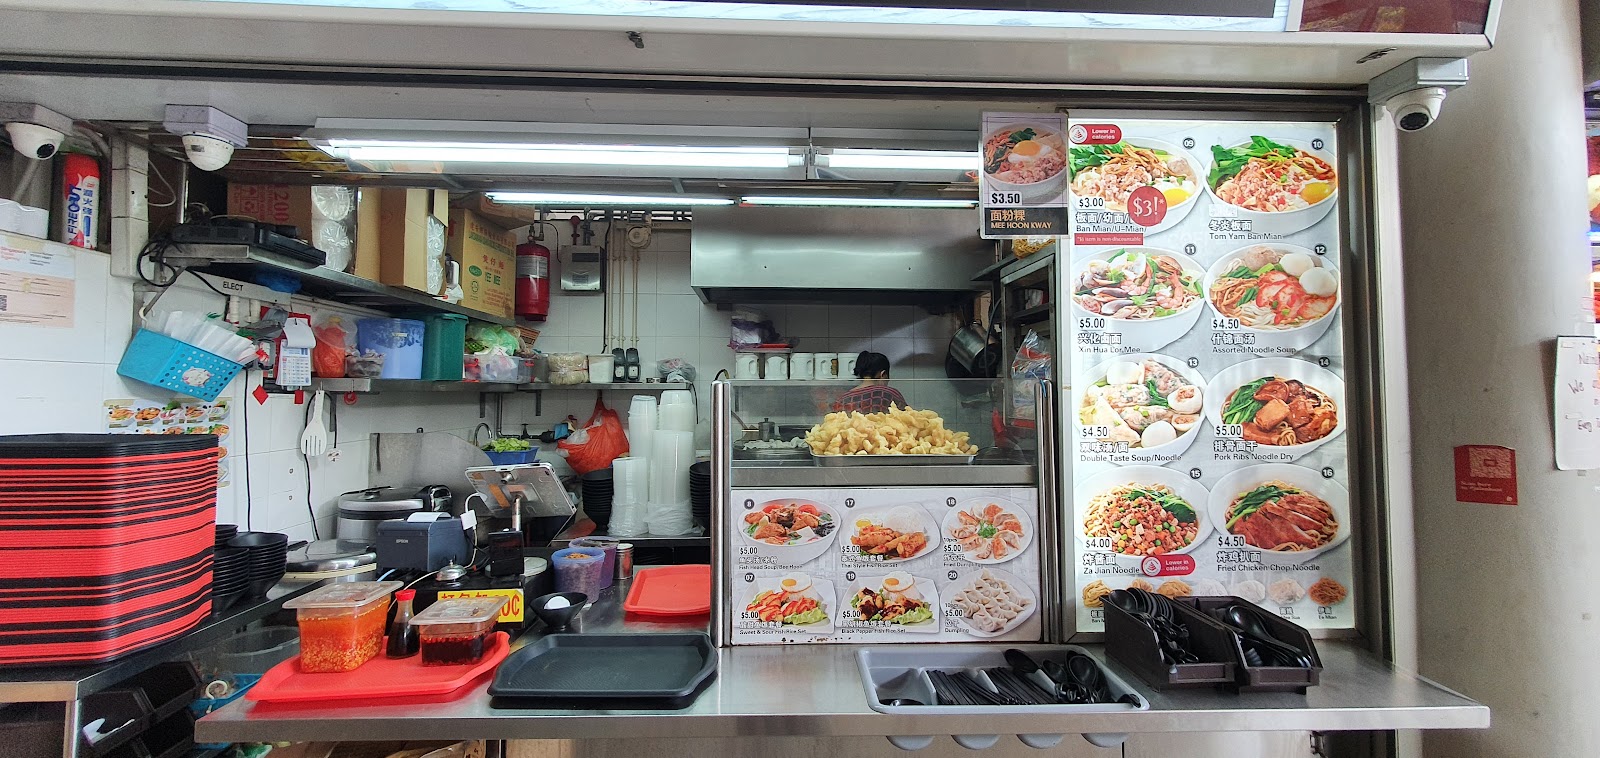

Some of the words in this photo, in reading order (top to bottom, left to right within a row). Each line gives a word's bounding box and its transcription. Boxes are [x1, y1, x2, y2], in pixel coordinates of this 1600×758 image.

[1313, 141, 1322, 149] 10
[991, 192, 1020, 204] $3.50
[1079, 197, 1104, 208] $3.00
[67, 183, 82, 235] FIREOUT
[990, 210, 1025, 221] 面粉粿
[1076, 225, 1091, 233] Ban
[1316, 246, 1325, 254] 12
[222, 281, 244, 292] ELECT
[1079, 318, 1105, 329] $5.00
[1212, 319, 1239, 329] $4.50
[1211, 333, 1255, 345] 什锦面汤
[1212, 346, 1246, 354] Assorted
[1248, 346, 1275, 354] Noodle
[1276, 346, 1297, 355] Soup
[1319, 358, 1329, 366] 14
[1082, 426, 1108, 437] $4.50
[1216, 425, 1242, 437] $5.00
[1191, 470, 1201, 478] 15
[1322, 469, 1333, 477] 16
[1085, 538, 1110, 549] $4.00
[1218, 536, 1245, 547] $4.50
[740, 547, 758, 555] $5.00
[841, 545, 860, 554] $5.00
[943, 544, 962, 552] $5.00
[1216, 551, 1262, 563] 炸鸡扒面
[1217, 564, 1236, 572] Fried
[1238, 564, 1268, 572] Chicken
[1269, 564, 1292, 573] Chop
[1292, 564, 1320, 572] Noodle
[741, 611, 759, 619] $5.00
[842, 610, 861, 618] $5.00
[945, 609, 963, 617] $5.00
